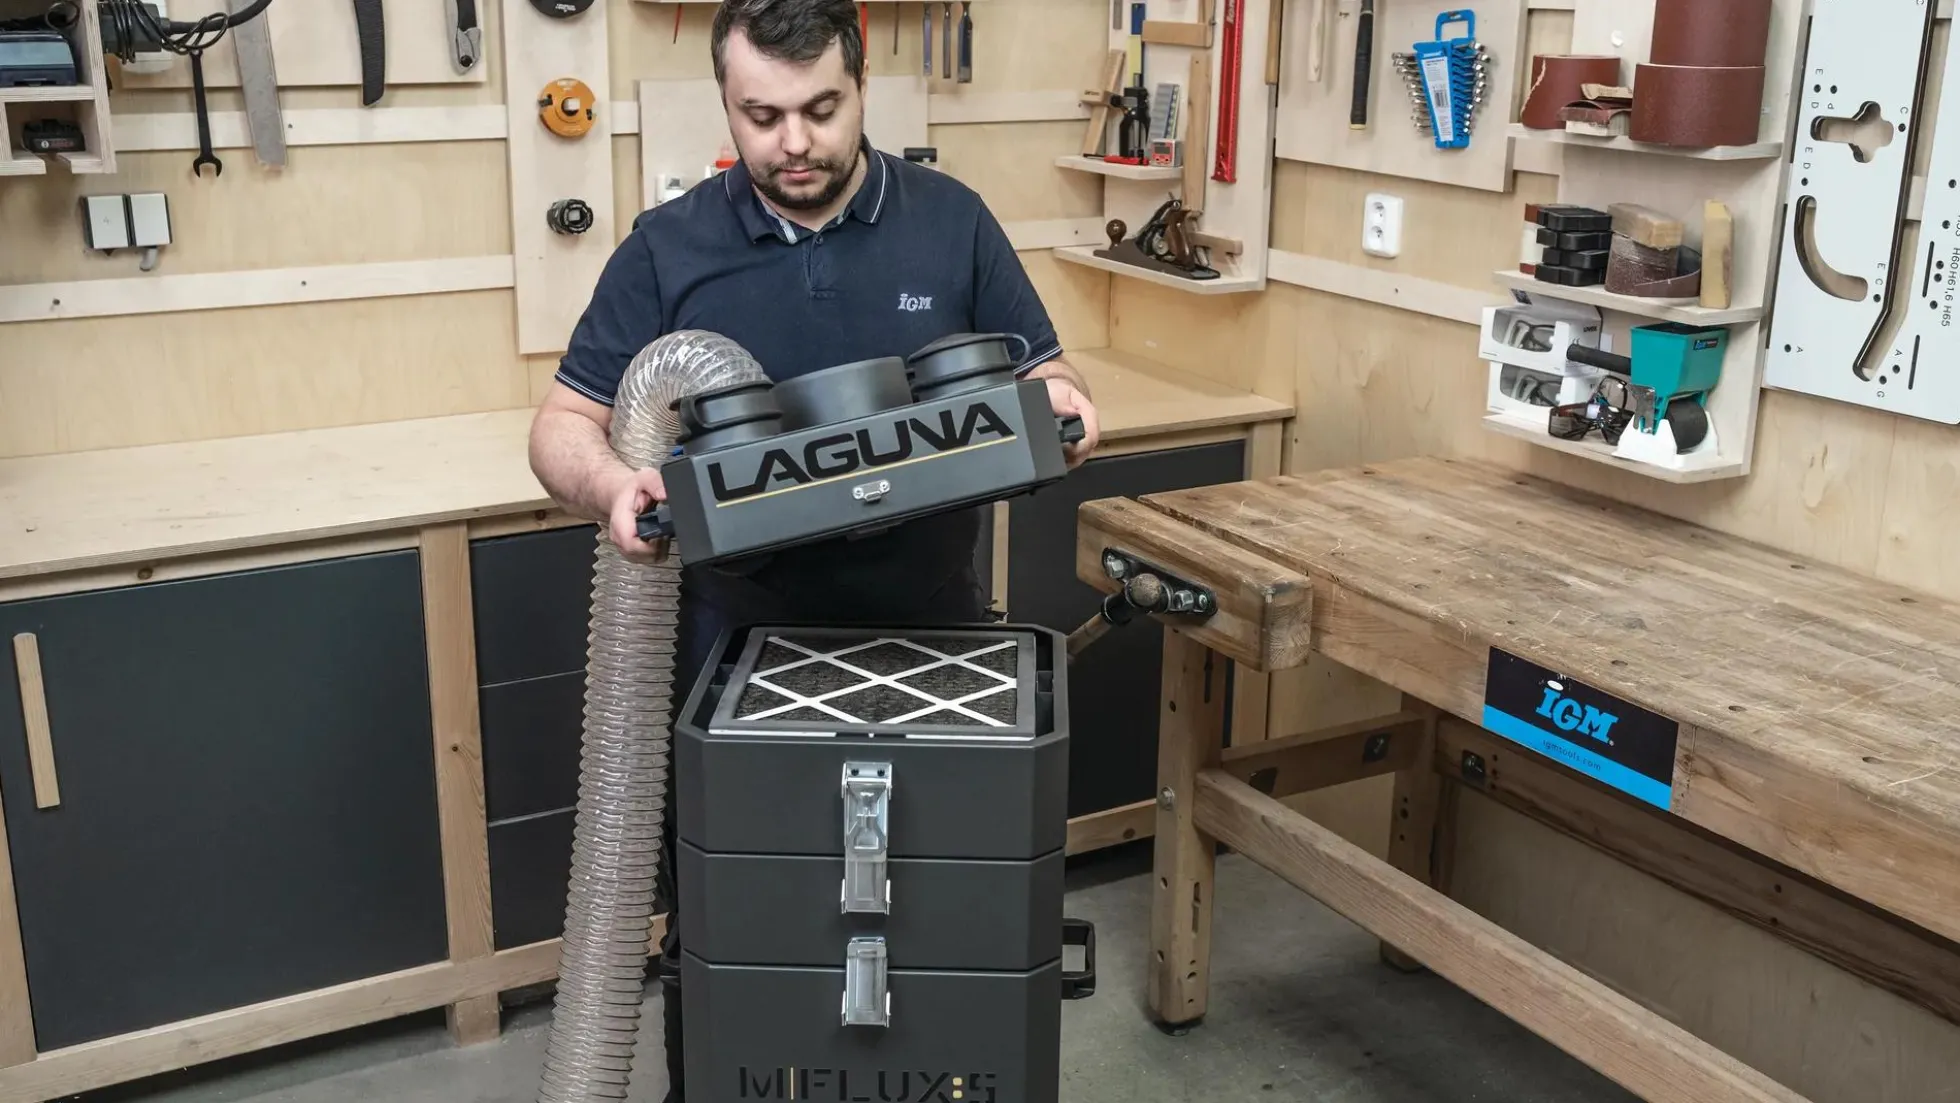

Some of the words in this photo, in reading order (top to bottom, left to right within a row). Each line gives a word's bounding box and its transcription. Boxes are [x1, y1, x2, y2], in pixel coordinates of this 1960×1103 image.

[1941, 305, 1952, 327] H65
[707, 401, 1015, 501] LAGUNA
[1542, 739, 1602, 770] igmtools.com
